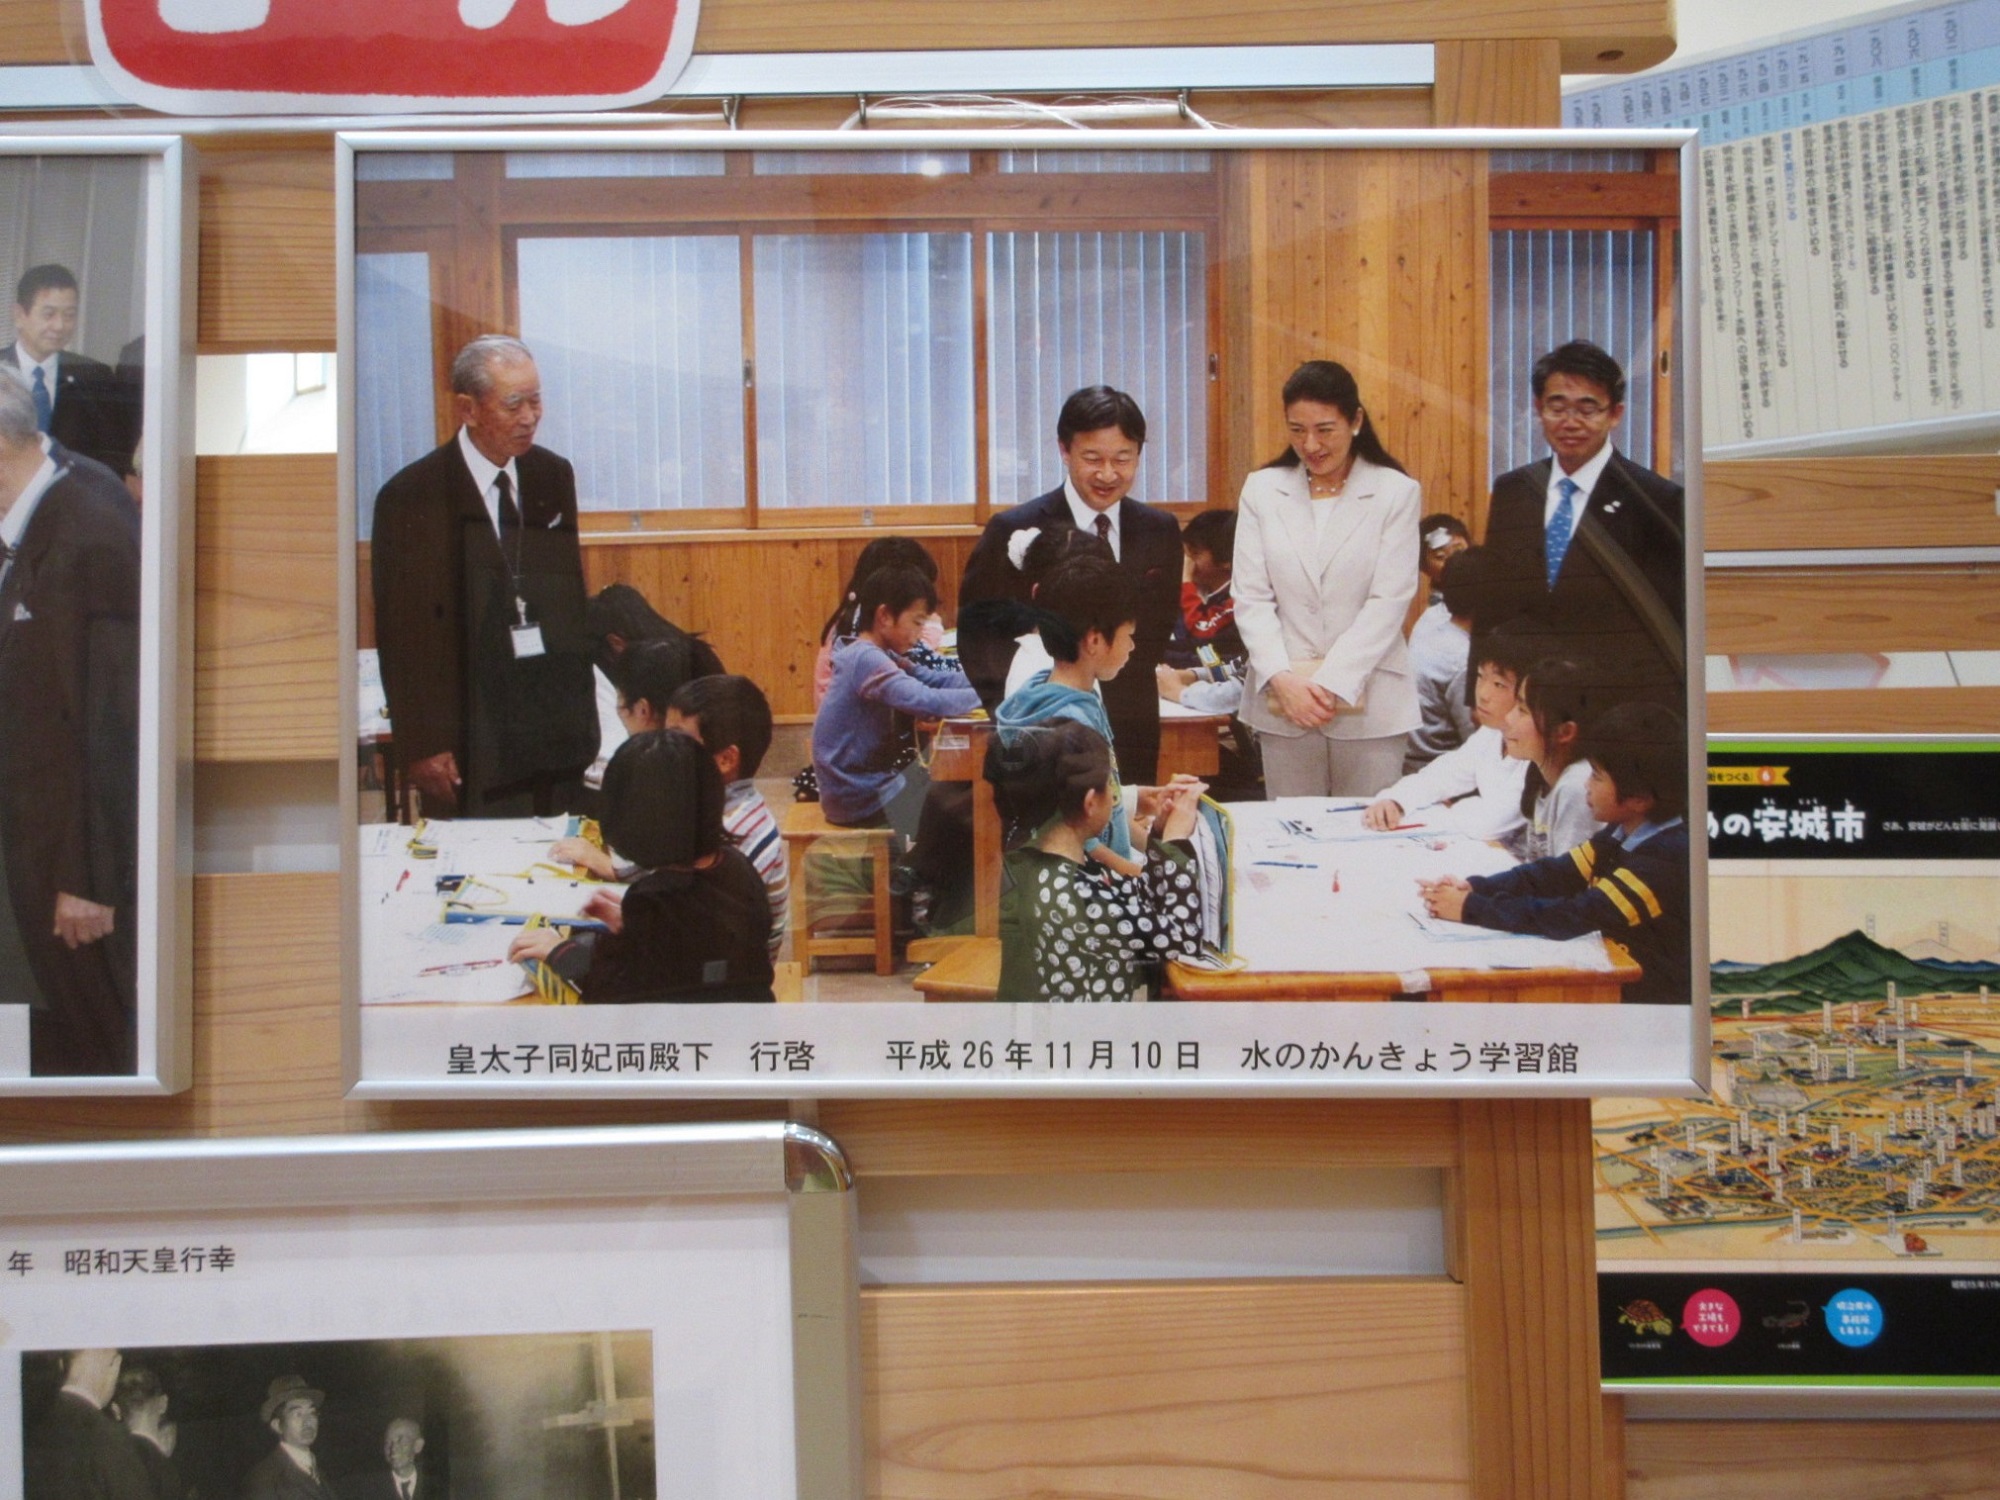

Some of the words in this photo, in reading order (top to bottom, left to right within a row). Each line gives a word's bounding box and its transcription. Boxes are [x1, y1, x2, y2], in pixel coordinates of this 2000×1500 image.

[1882, 820, 2000, 832] さあ、安城がどんな街に発展
[446, 1042, 714, 1075] 皇太子同妃両殿下
[749, 1040, 816, 1072] 行啓
[885, 1038, 1200, 1072] 平成26年11月10日
[1240, 1038, 1580, 1074] 水のかんきょう学習館
[8, 1250, 34, 1276] 年
[64, 1245, 236, 1276] 昭和天皇行幸
